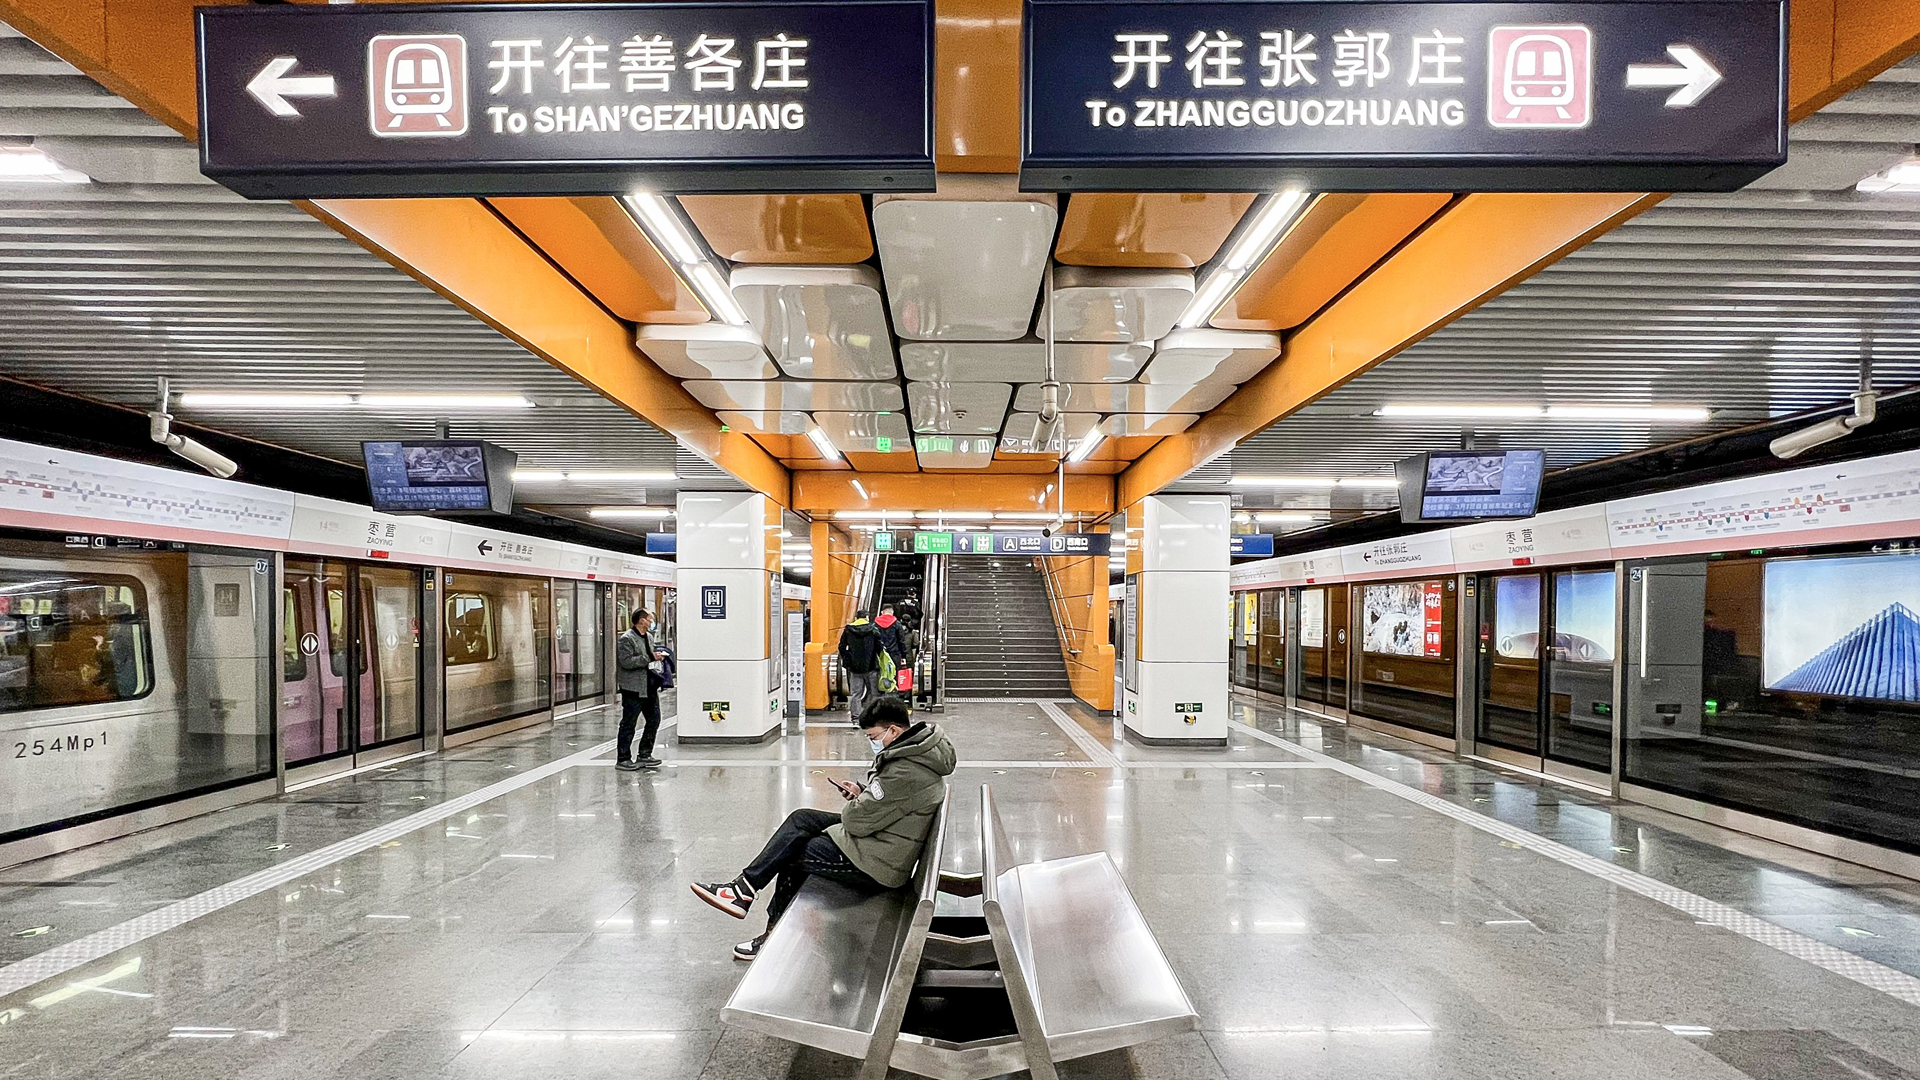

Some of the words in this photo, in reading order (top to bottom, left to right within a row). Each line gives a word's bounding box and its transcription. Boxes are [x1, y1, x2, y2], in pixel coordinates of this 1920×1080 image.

[487, 32, 808, 95] 开往善各庄
[1112, 29, 1464, 89] 开往张郭庄
[487, 105, 527, 133] To
[533, 103, 805, 132] SHAN'GEZHUANG
[1085, 100, 1126, 127] To
[1134, 99, 1464, 127] ZHANGGUOZHUANG
[367, 521, 396, 538] 枣营
[1505, 528, 1533, 545] 枣营
[367, 536, 393, 547] ZAOYING
[1005, 538, 1016, 549] A
[1052, 538, 1063, 549] D
[1508, 544, 1534, 553] ZAOYING
[255, 561, 267, 571] 07
[1632, 569, 1642, 579] 24
[14, 731, 108, 759] 254Mp1
